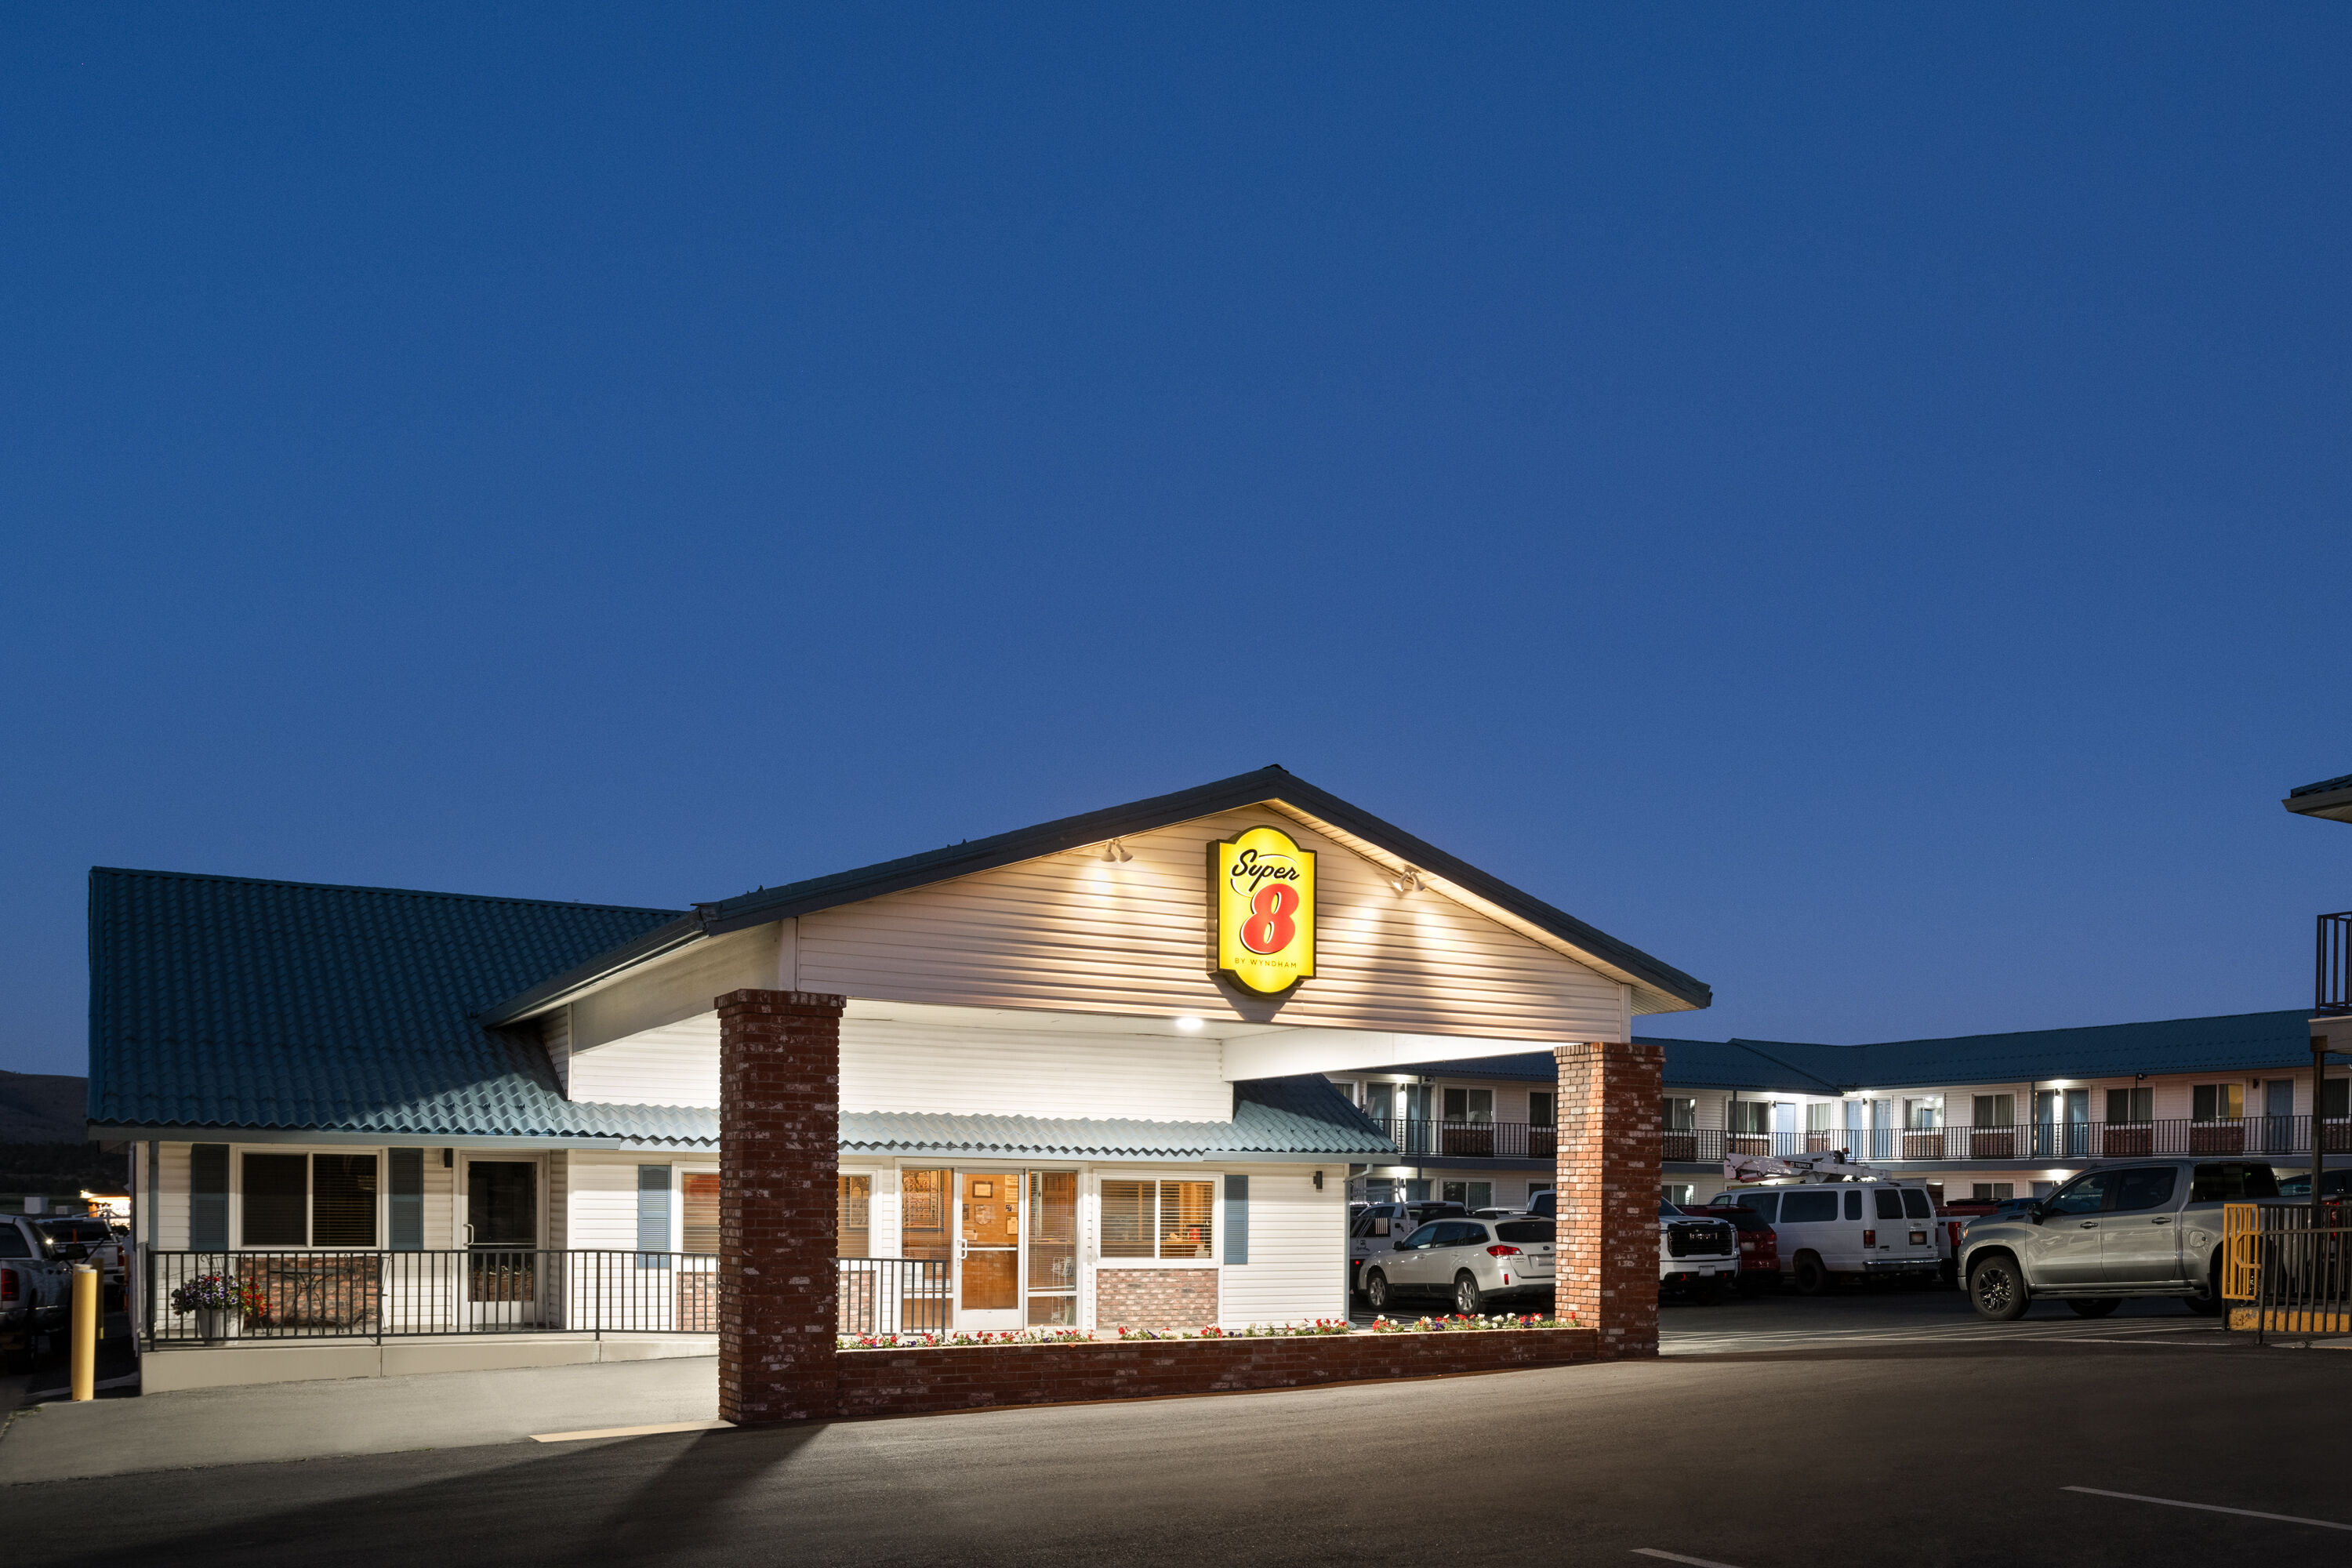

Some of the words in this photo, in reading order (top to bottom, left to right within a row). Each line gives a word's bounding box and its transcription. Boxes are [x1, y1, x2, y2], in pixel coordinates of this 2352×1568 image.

[1231, 849, 1300, 892] Super
[1240, 883, 1299, 955] 8
[1250, 959, 1297, 968] WYNDHAM
